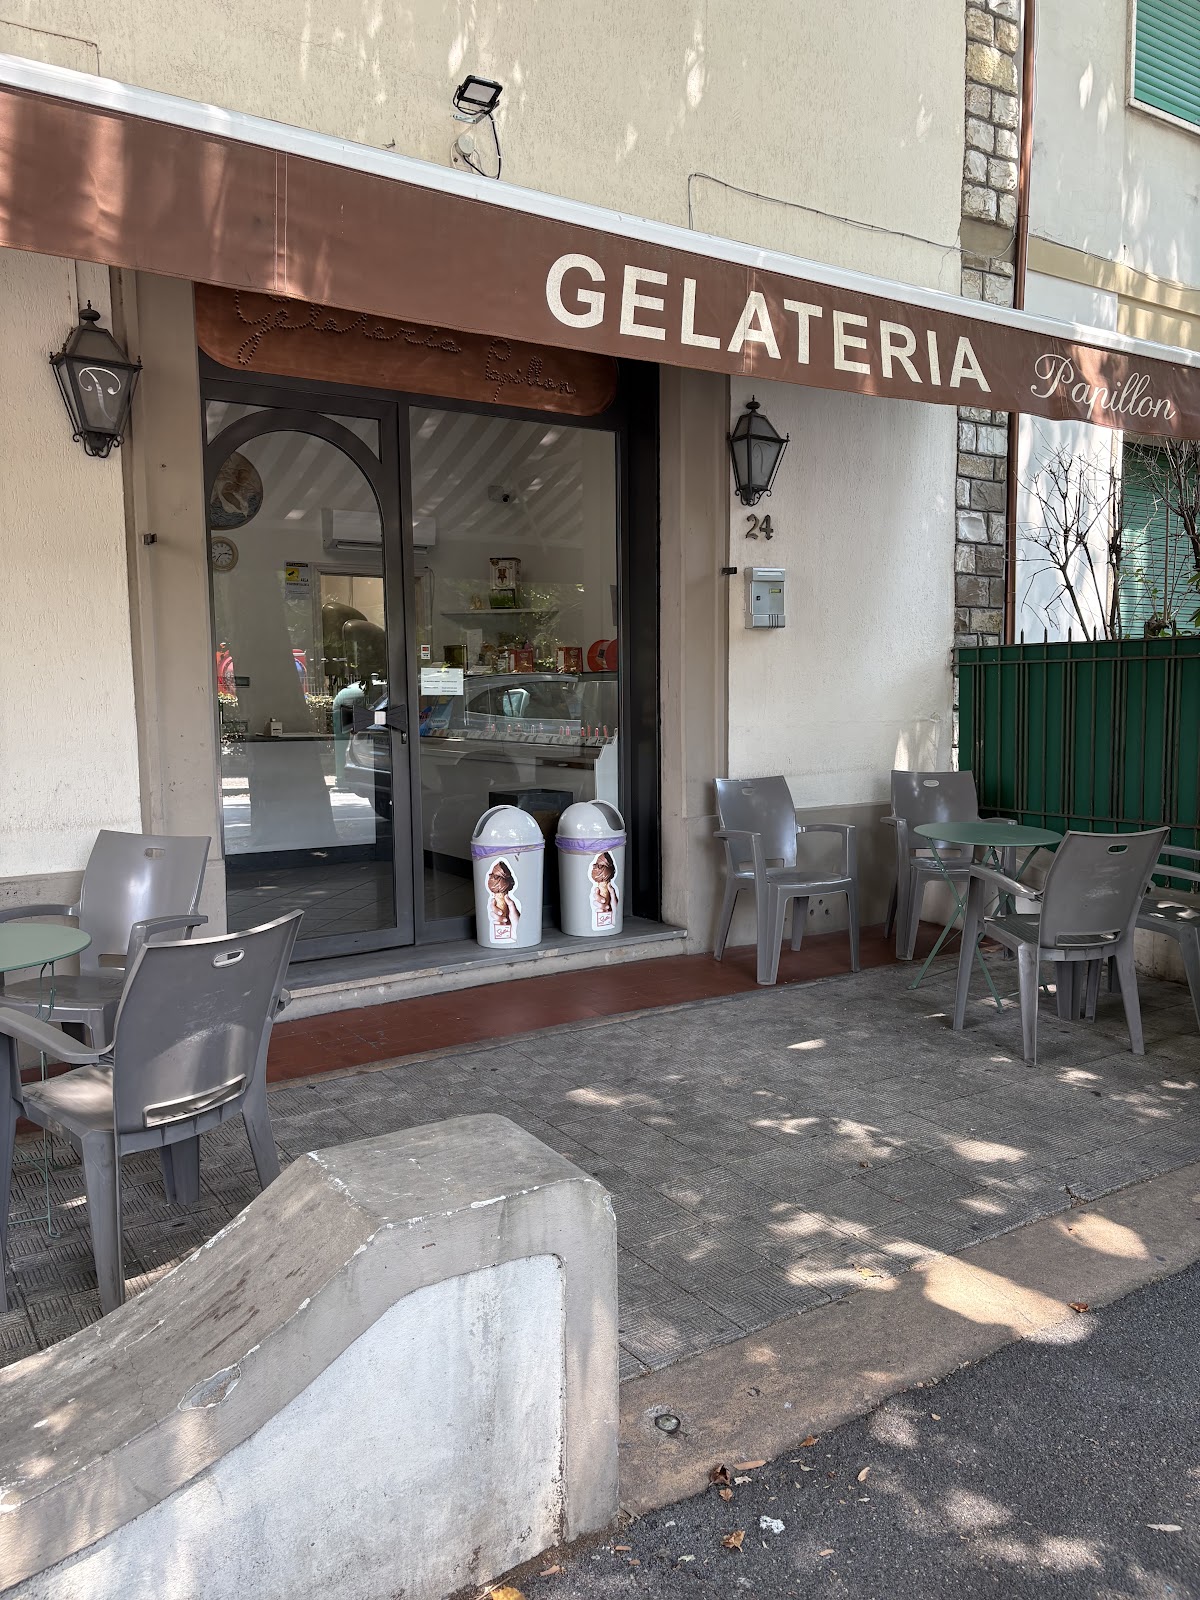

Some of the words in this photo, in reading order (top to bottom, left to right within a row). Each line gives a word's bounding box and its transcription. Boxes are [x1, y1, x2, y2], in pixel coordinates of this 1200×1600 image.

[545, 253, 992, 393] GELATERIA
[1030, 353, 1177, 421] Papillon
[745, 513, 774, 541] 24
